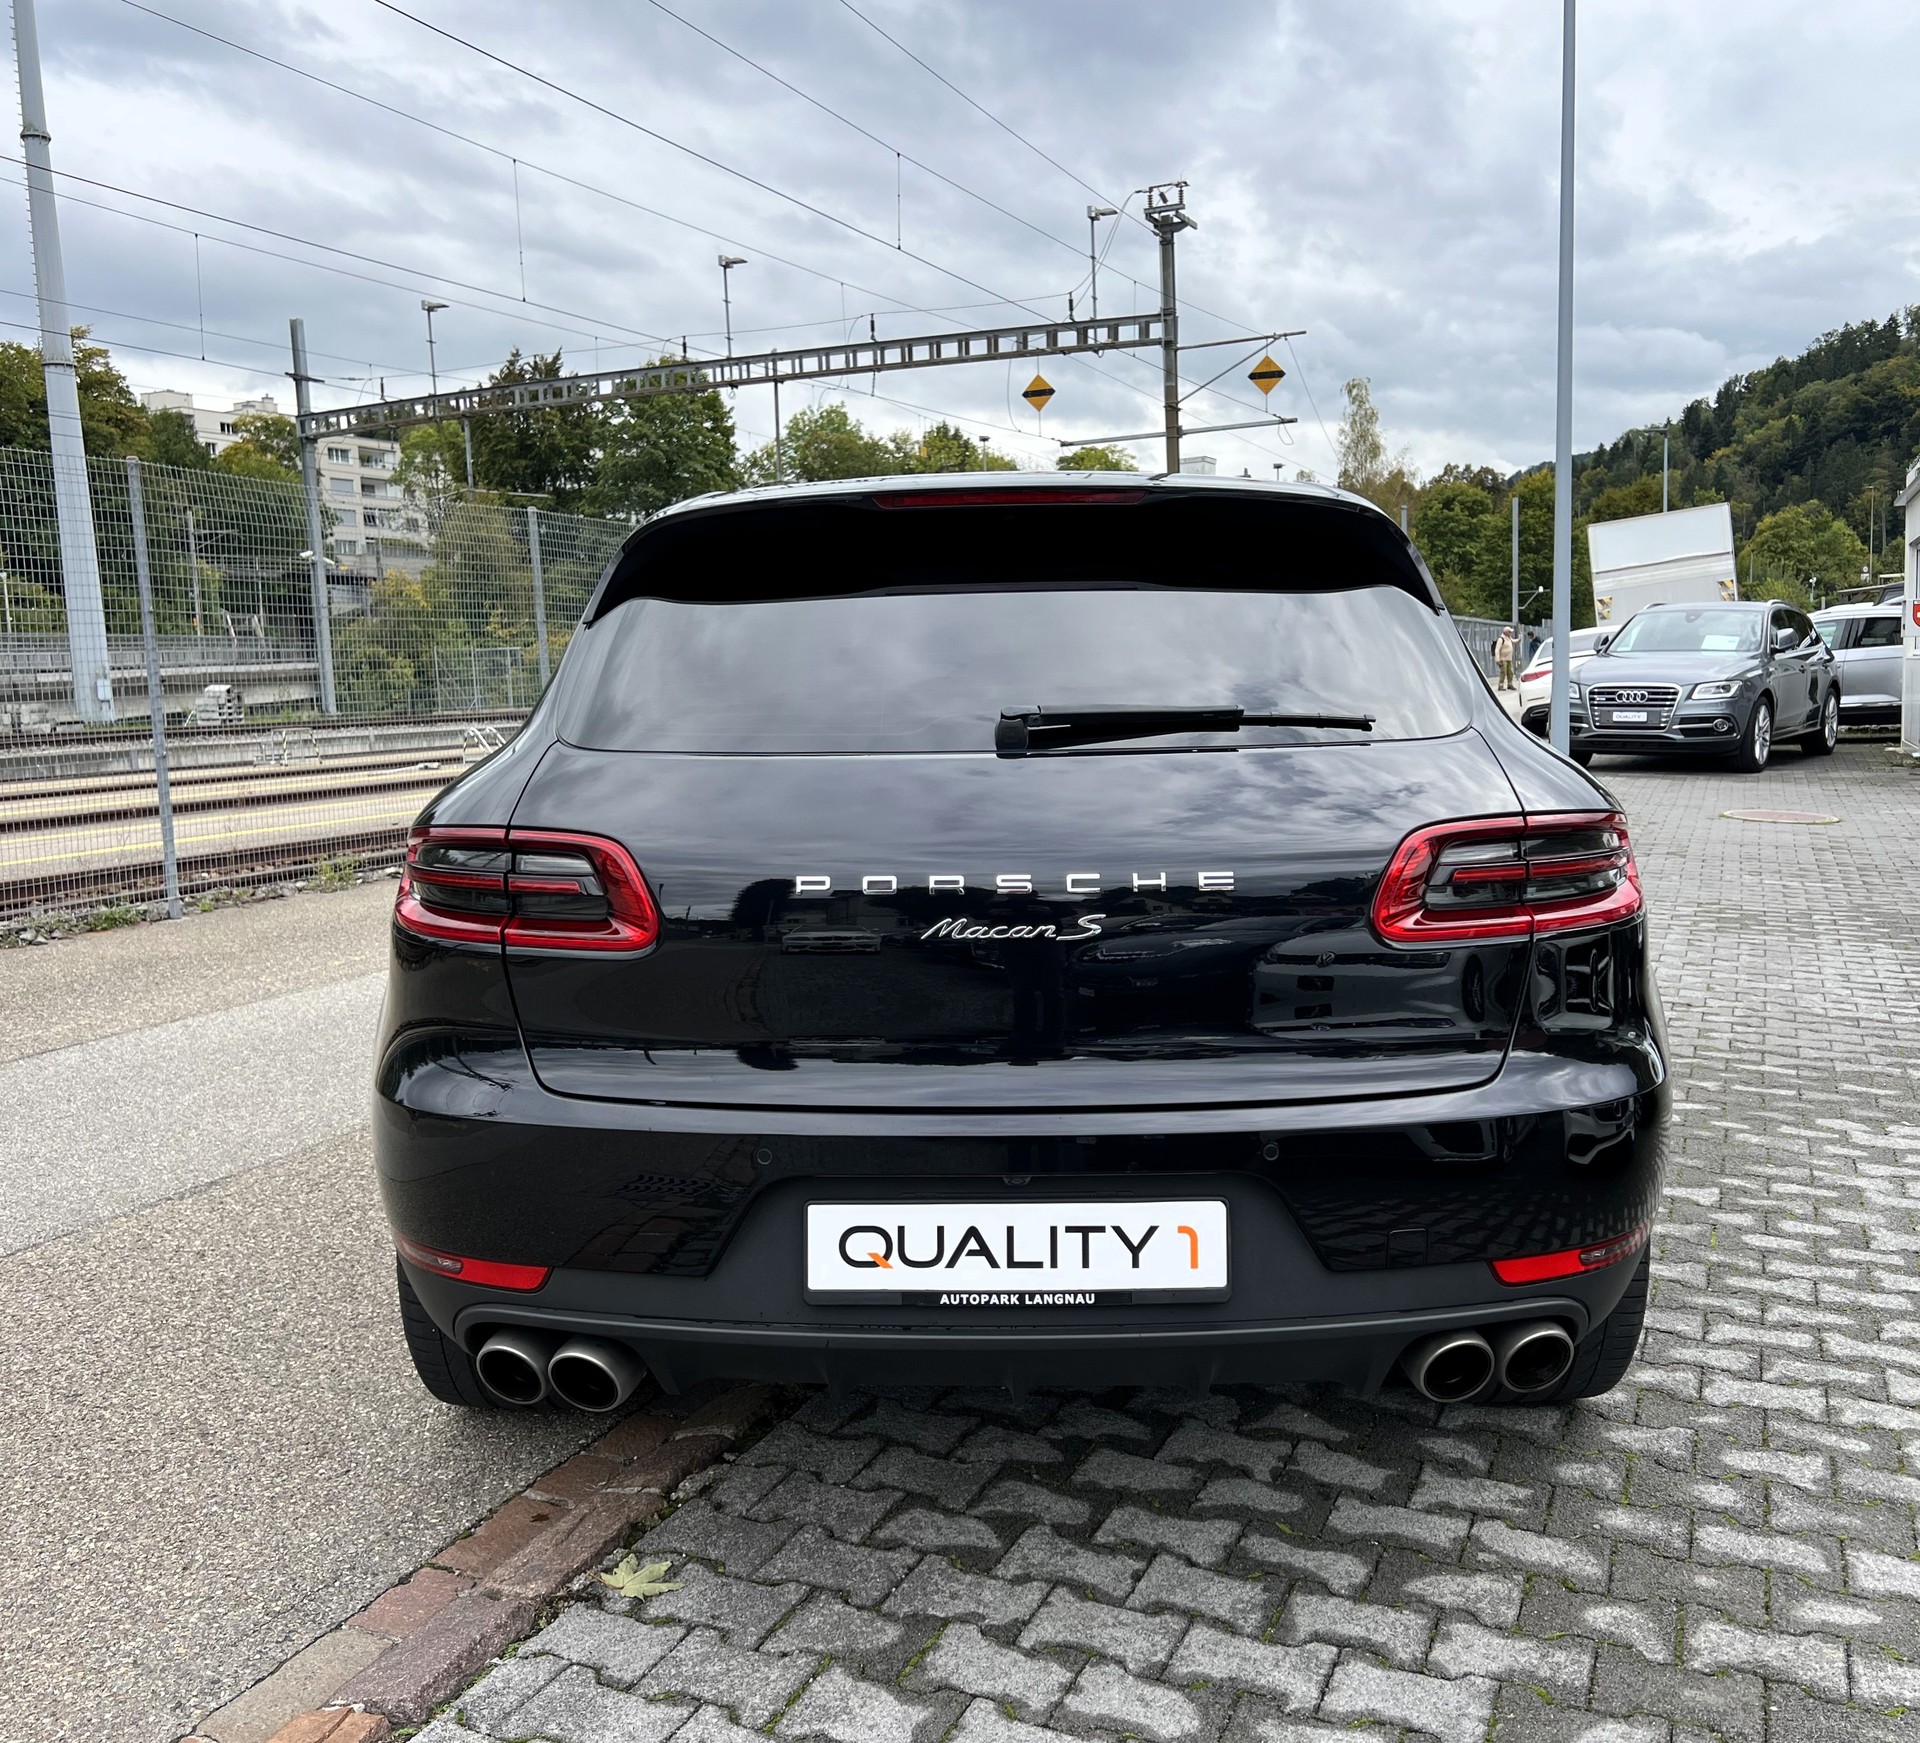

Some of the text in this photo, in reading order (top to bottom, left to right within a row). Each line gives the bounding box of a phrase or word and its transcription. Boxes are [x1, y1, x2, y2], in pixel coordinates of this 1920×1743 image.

[795, 871, 1236, 896] PORSCHE
[920, 913, 1107, 941] Macan S
[839, 1225, 1199, 1270] QUALITY 1
[940, 1293, 1095, 1305] AUTOPARK LANGNAU
